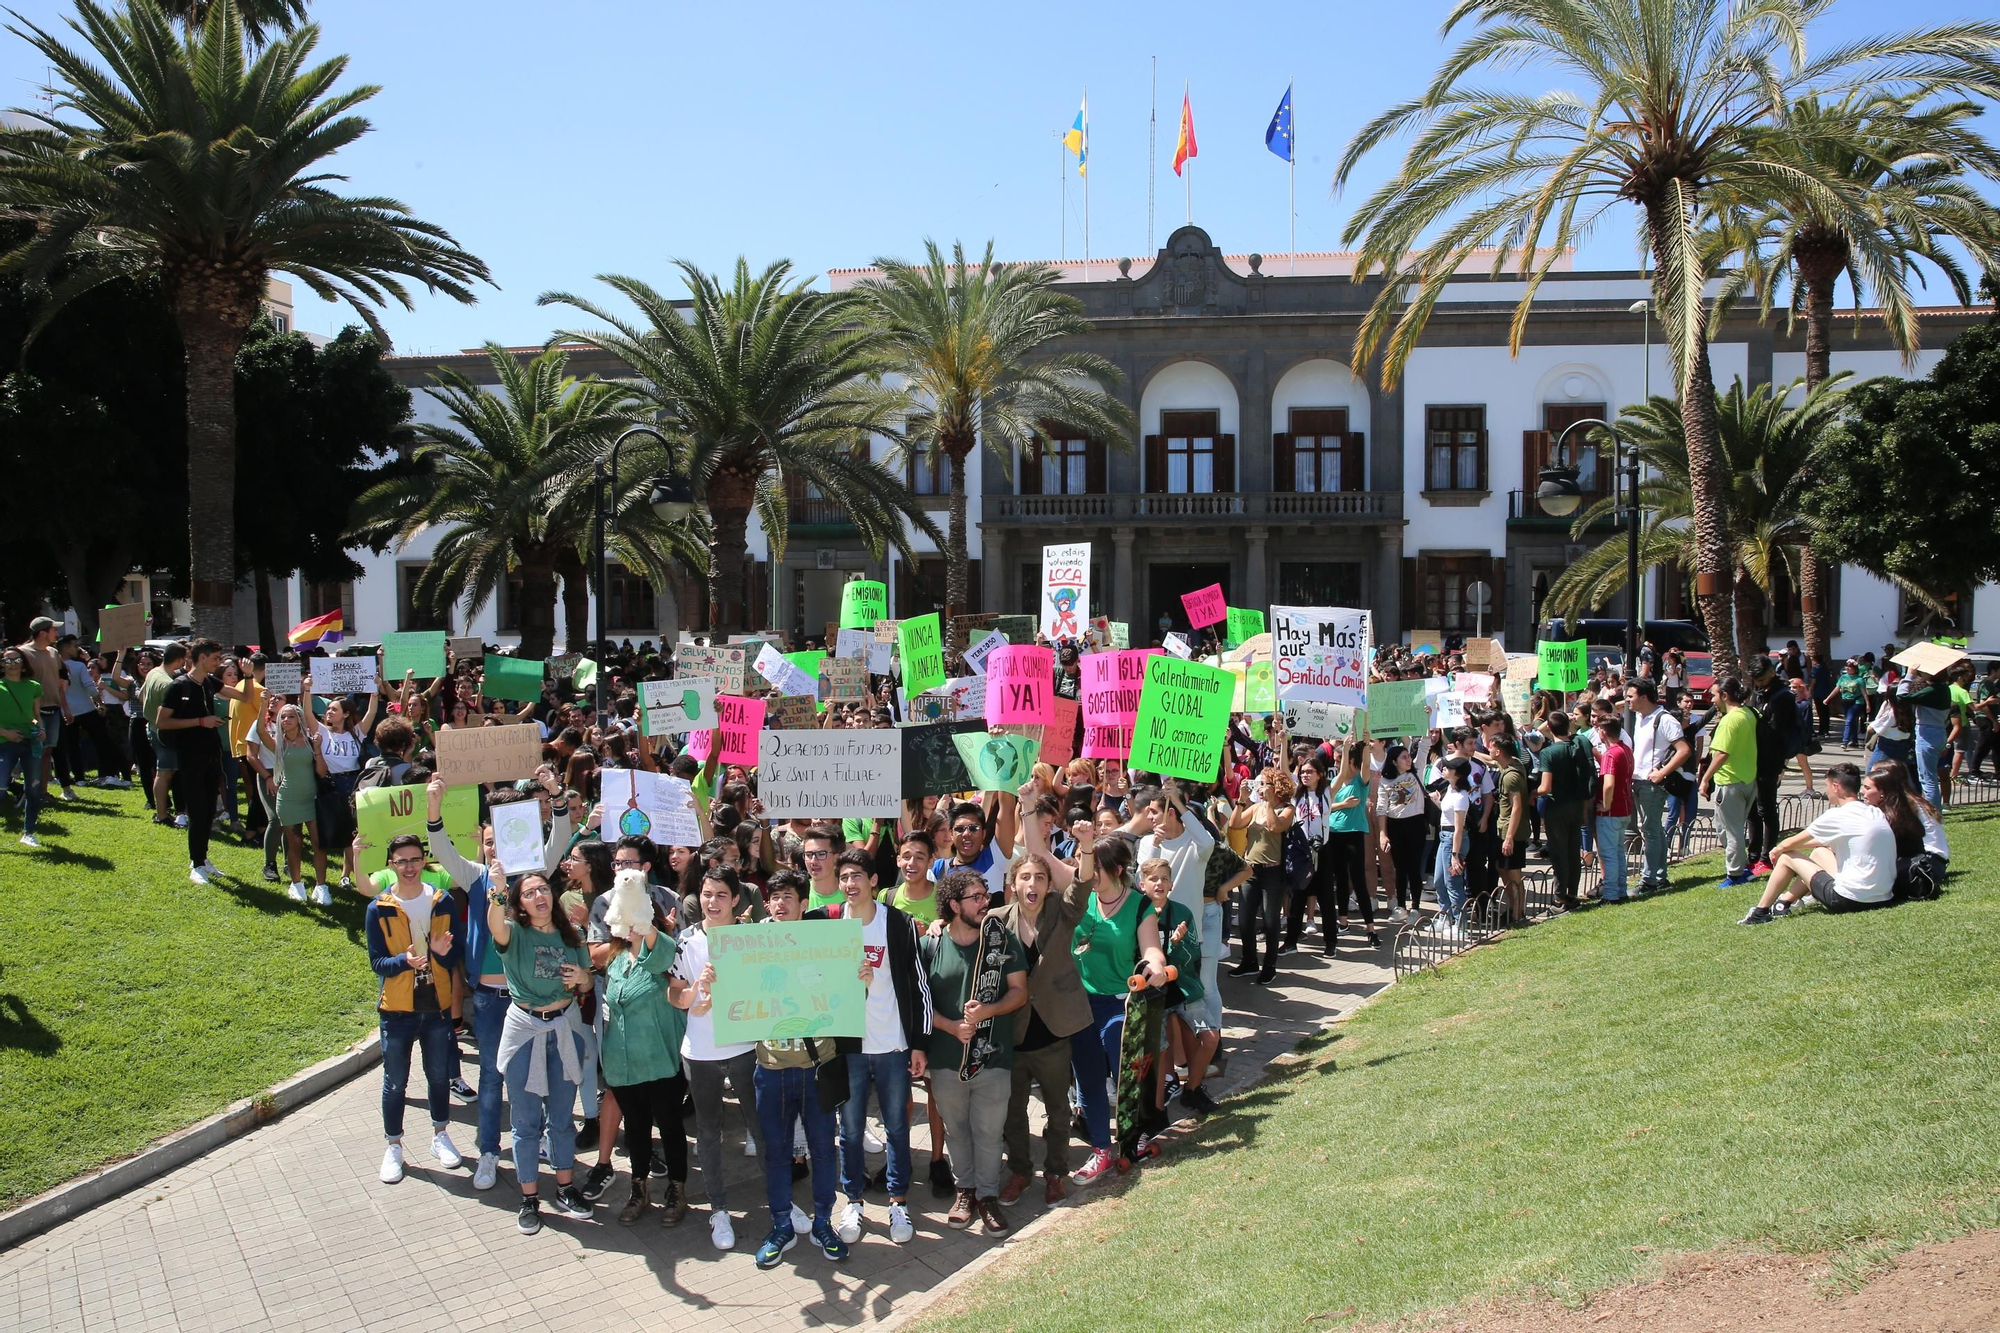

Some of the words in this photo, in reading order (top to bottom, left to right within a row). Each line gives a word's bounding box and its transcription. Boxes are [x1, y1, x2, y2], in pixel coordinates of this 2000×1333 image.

[1049, 558, 1083, 566] volviendo
[1049, 568, 1082, 582] LOCA
[852, 585, 882, 602] EMISIONES
[862, 608, 879, 620] VIDA
[1195, 604, 1218, 623] ¡YA!
[1276, 618, 1310, 645] Hay
[1318, 622, 1356, 648] Más
[681, 647, 707, 657] SALVA
[712, 649, 724, 658] TU
[983, 637, 997, 651] 2050
[1280, 644, 1306, 657] QUE
[1546, 646, 1578, 662] EMISIONES
[680, 661, 692, 670] NO
[694, 662, 743, 675] TENEMOS
[841, 668, 860, 676] LUNA
[1096, 656, 1109, 682] MI
[1118, 655, 1144, 680] ISLA
[1278, 658, 1330, 686] Sentido
[1333, 666, 1365, 689] Común
[1560, 666, 1579, 683] VIDA
[731, 677, 740, 689] B
[1152, 661, 1220, 694] Calentamiento
[925, 697, 952, 709] EXISTE
[1000, 680, 1042, 716] ¡YA!
[1162, 691, 1204, 718] GLOBAL
[1307, 707, 1328, 716] CHANGE
[1150, 716, 1167, 739] NO
[1172, 730, 1208, 746] conoce
[325, 739, 357, 756] LOVE
[693, 728, 747, 754] SOSNIBLE
[495, 757, 512, 772] TÚ
[1148, 743, 1212, 773] FRONTERAS
[786, 766, 816, 782] WANT
[822, 770, 829, 781] A
[389, 789, 413, 816] NO
[857, 791, 893, 807] AVENIR
[708, 929, 796, 960] ¿PODRÍAS
[727, 996, 799, 1021] ELLAS
[811, 993, 841, 1011] NO
